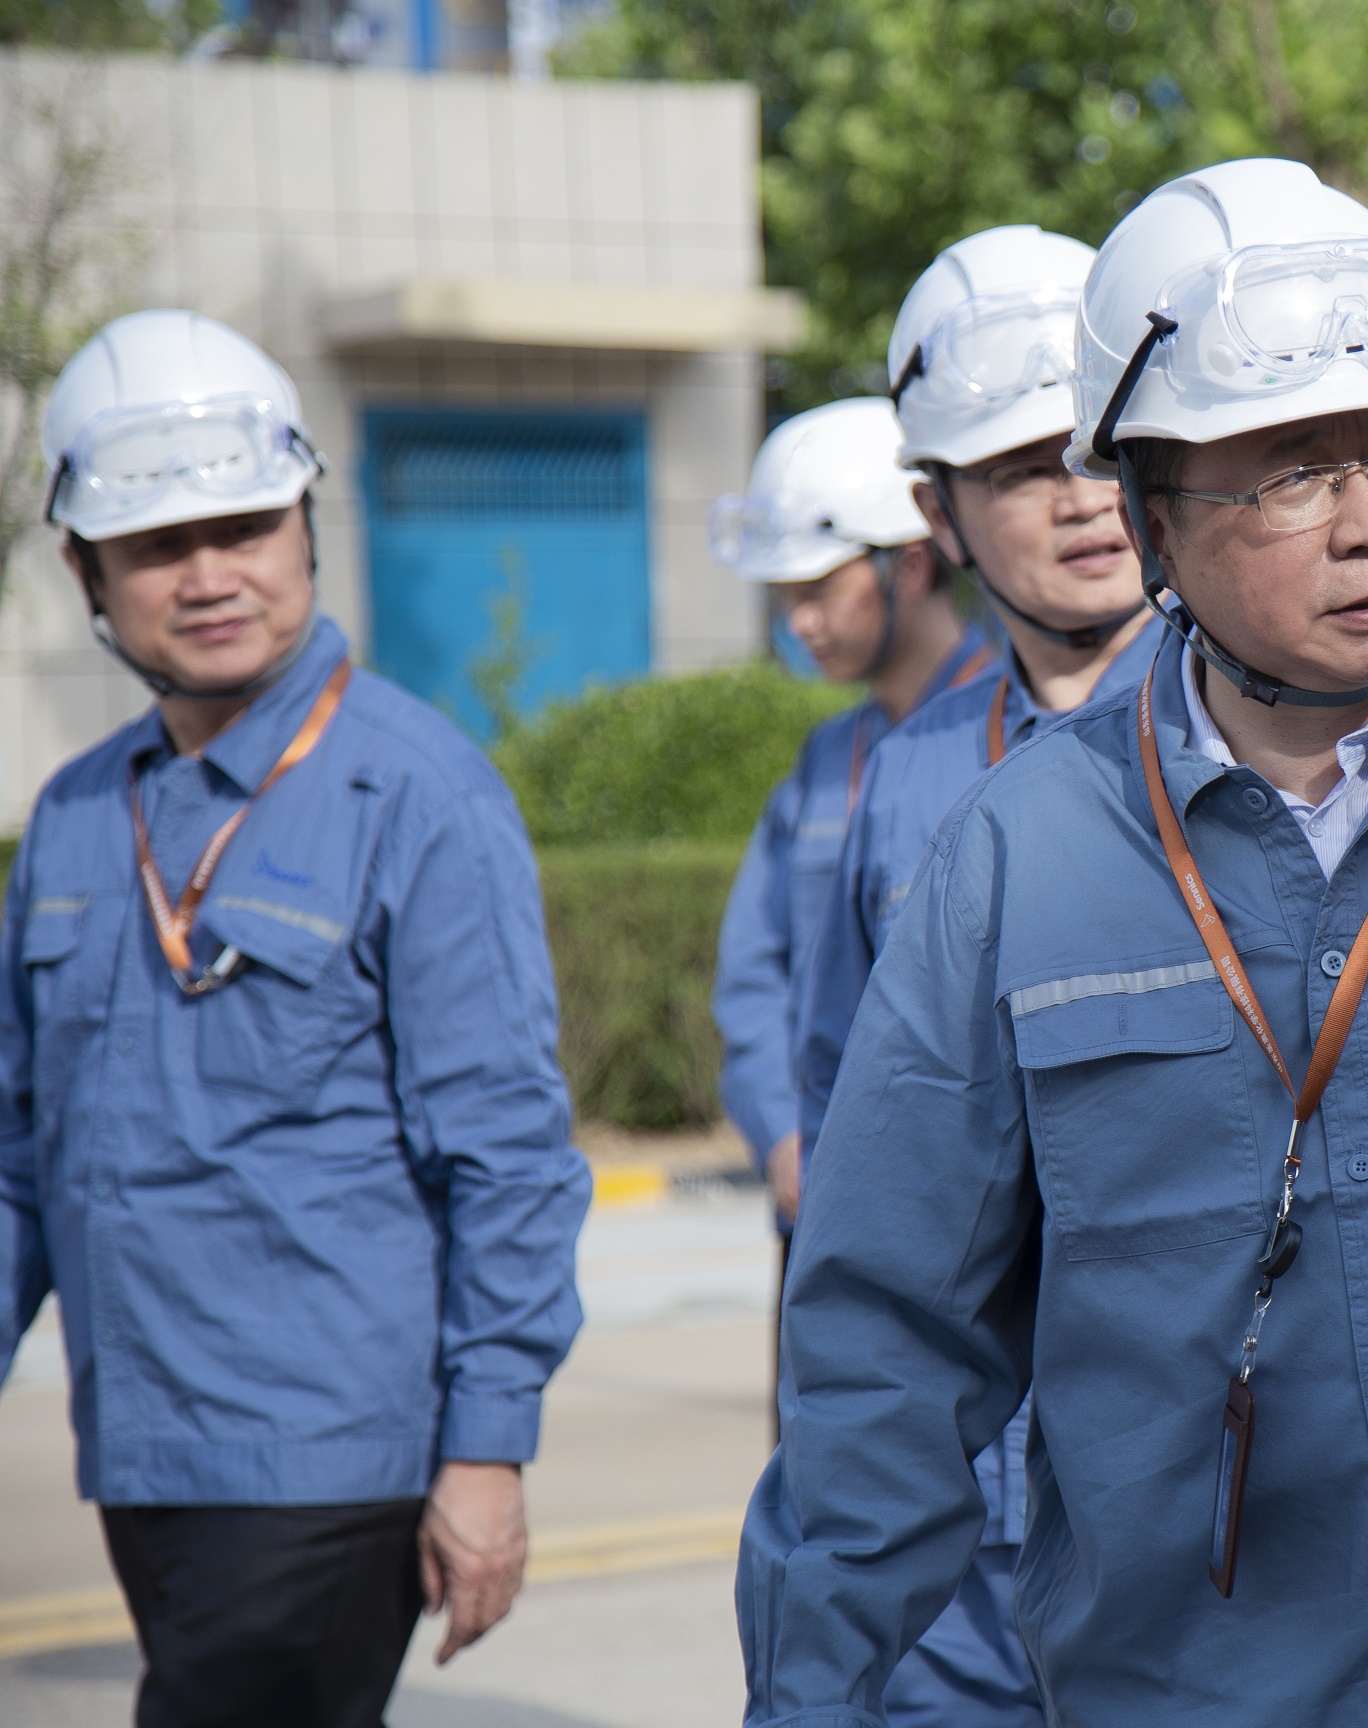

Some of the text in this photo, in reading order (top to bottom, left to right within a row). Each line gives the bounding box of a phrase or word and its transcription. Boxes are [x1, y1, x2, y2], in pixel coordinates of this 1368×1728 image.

[1185, 873, 1205, 911] Sennics
[1220, 955, 1283, 1073] 山东圣奥化学科技有限公司
